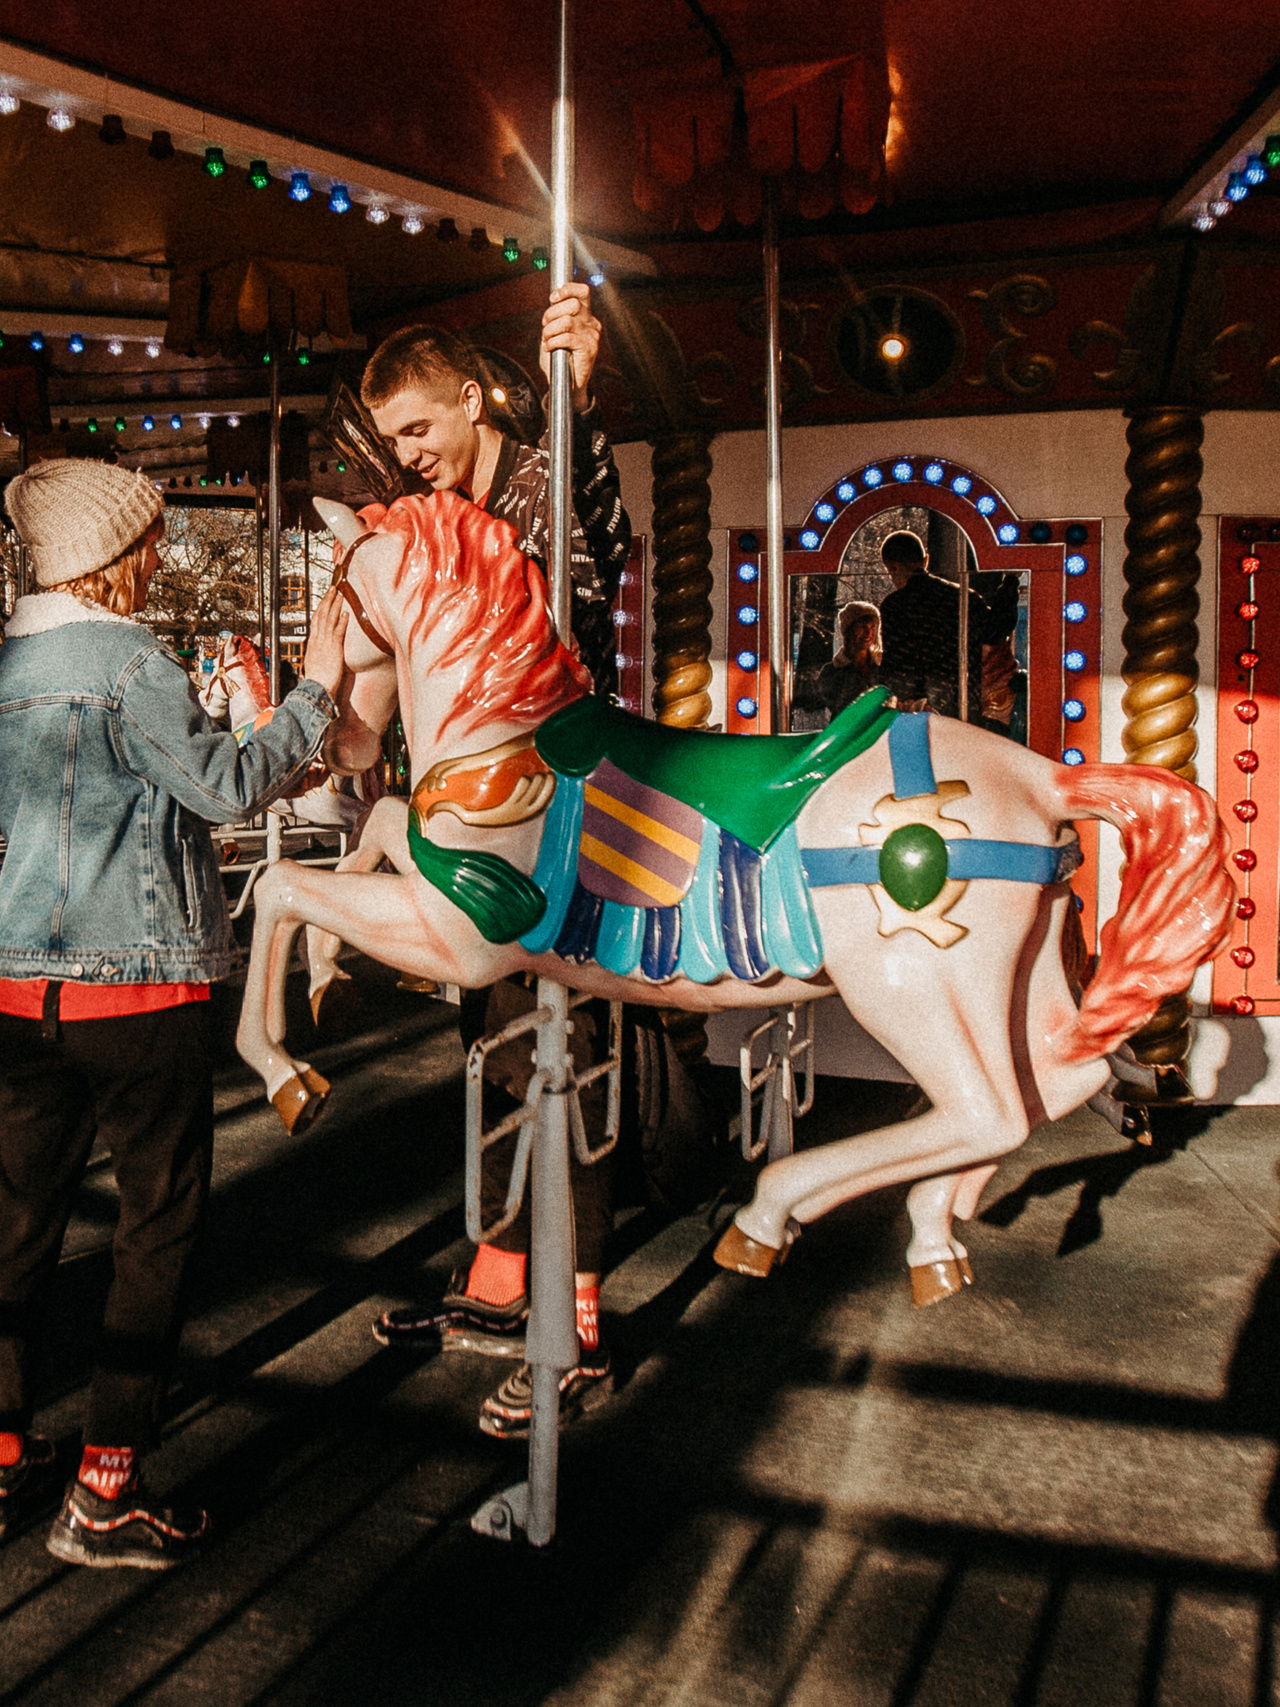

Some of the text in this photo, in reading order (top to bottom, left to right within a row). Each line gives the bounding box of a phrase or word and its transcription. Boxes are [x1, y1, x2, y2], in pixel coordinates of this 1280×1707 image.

[606, 496, 622, 534] MISTAKE
[576, 1299, 594, 1311] KI
[582, 1313, 597, 1326] M
[100, 1453, 132, 1469] MY
